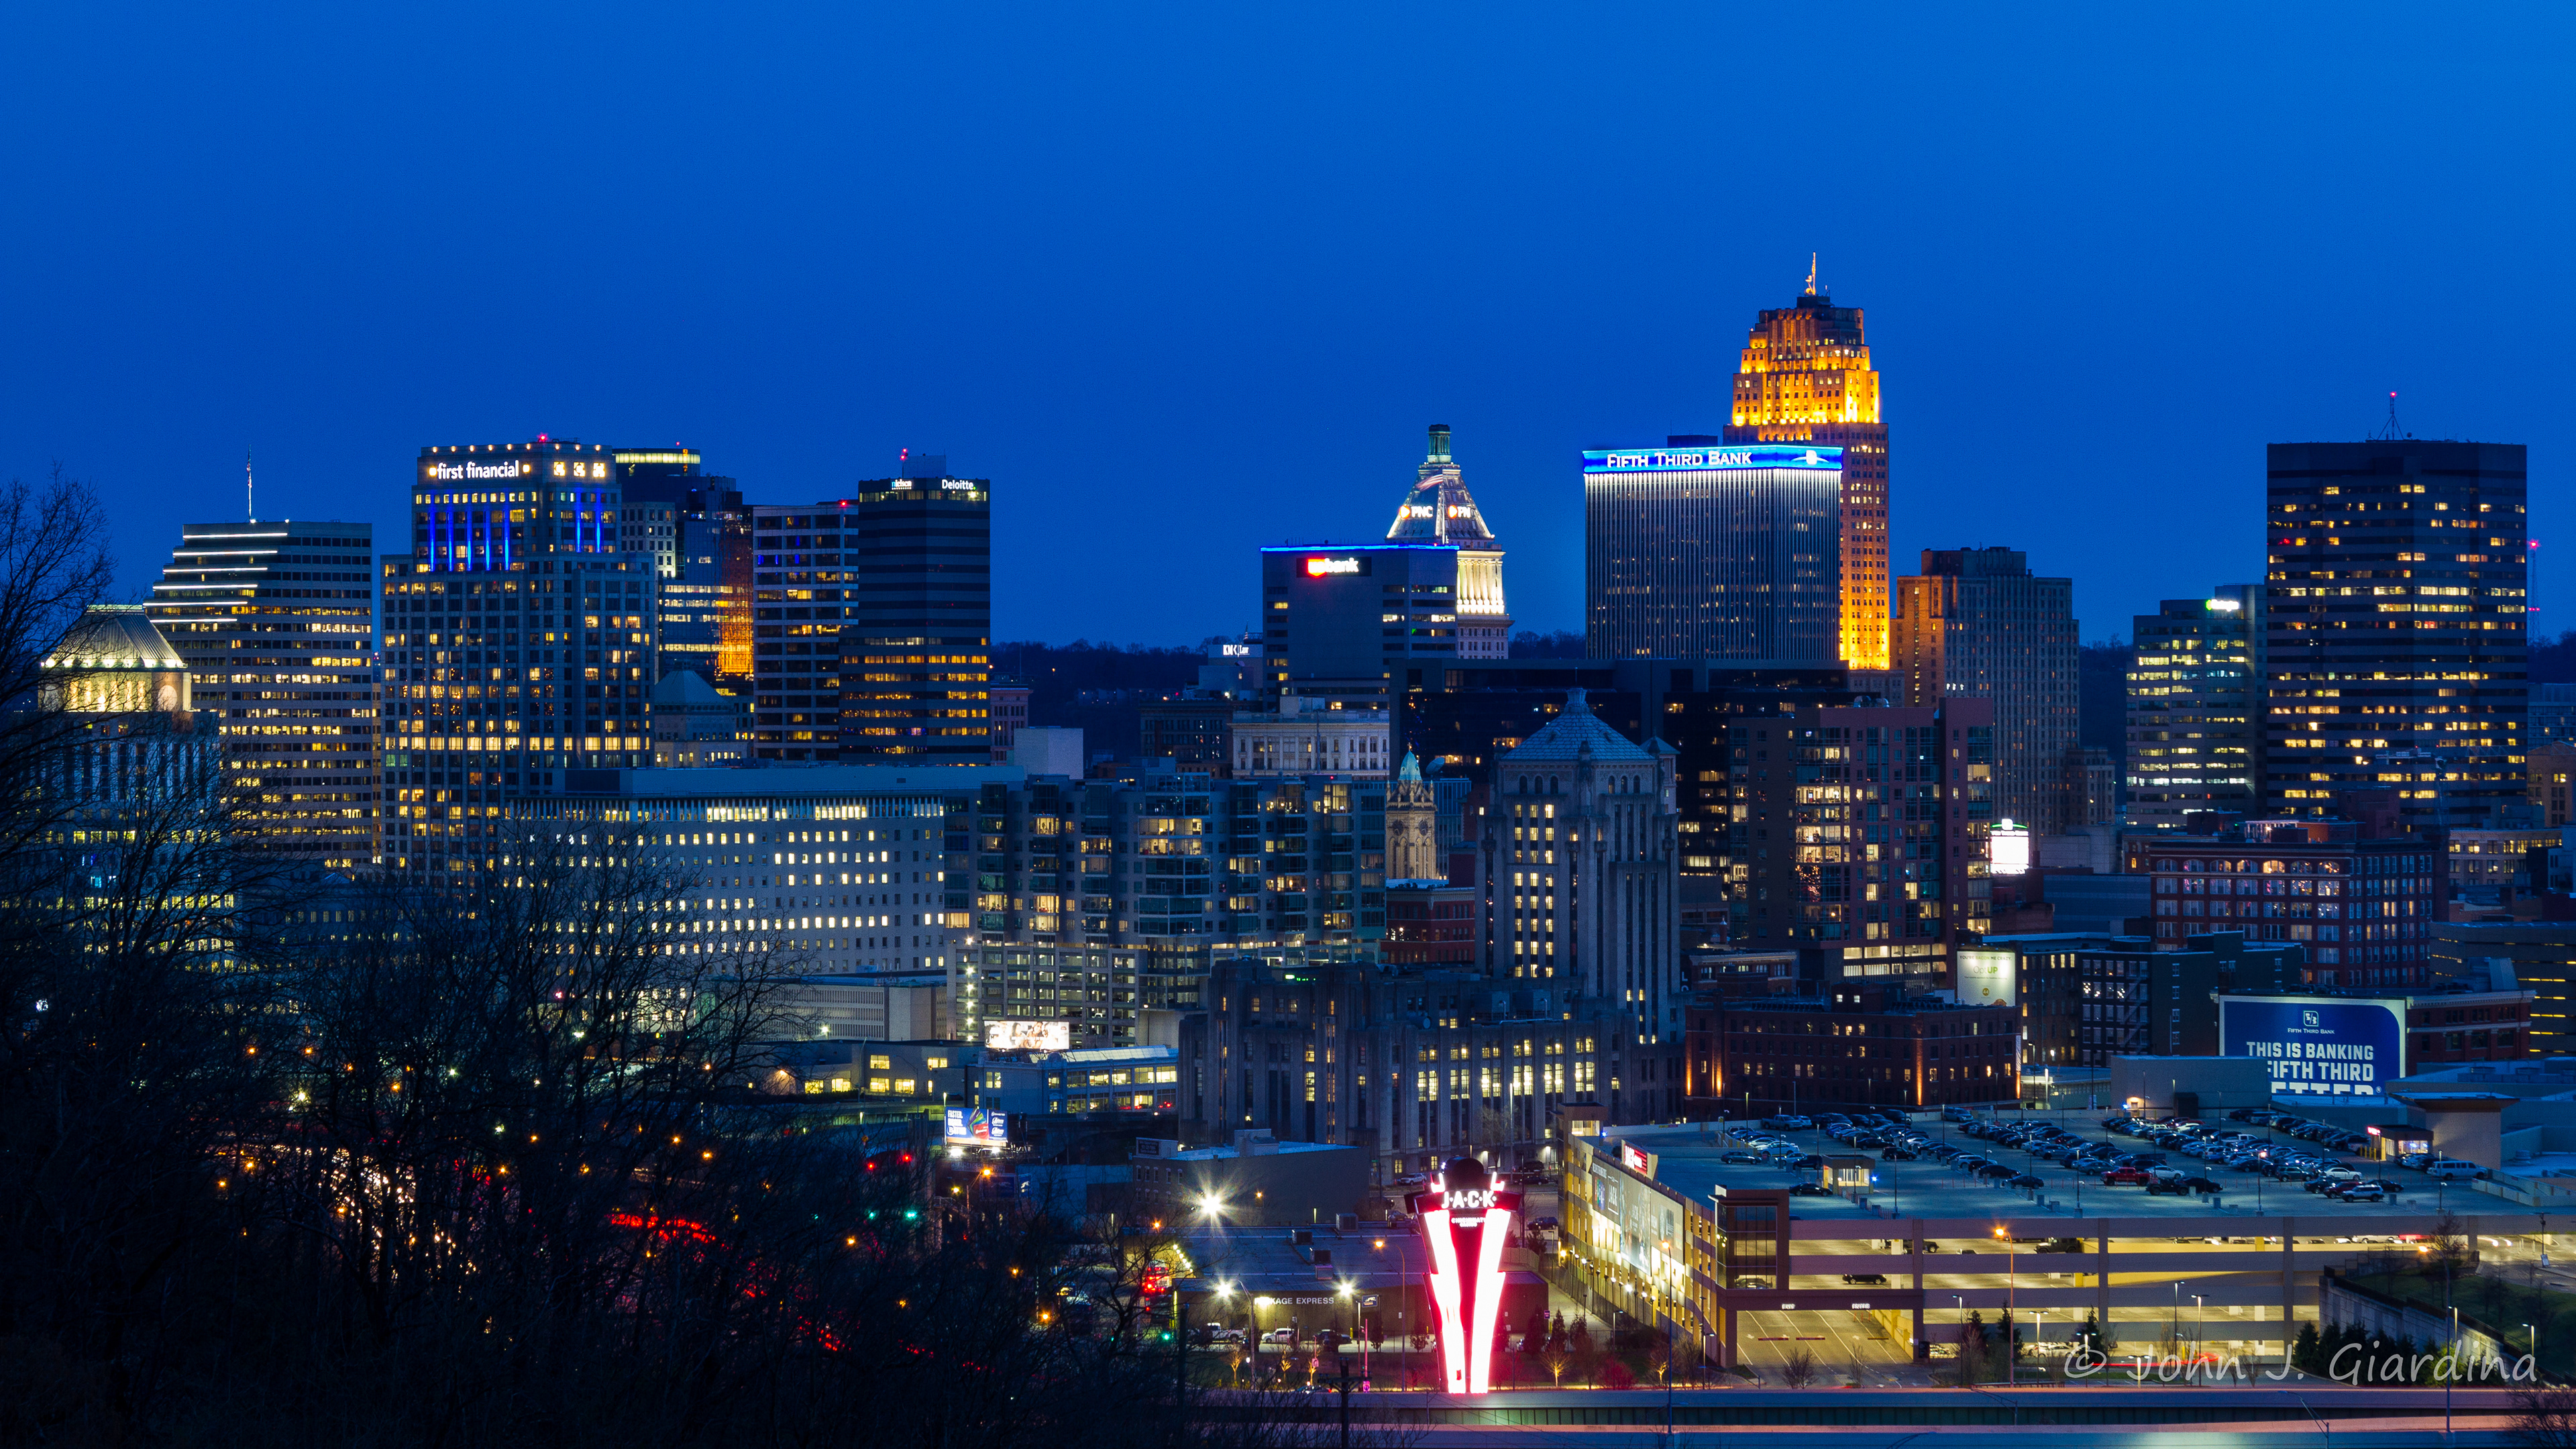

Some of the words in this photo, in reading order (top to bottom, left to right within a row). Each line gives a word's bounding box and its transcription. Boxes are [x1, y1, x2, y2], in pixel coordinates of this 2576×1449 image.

[1607, 454, 1649, 468] FIFTH
[1654, 452, 1703, 466] THIRD
[1708, 451, 1753, 465] BANK
[437, 462, 464, 479] first
[466, 460, 519, 478] financial
[1411, 506, 1434, 518] PNC
[2247, 1041, 2282, 1058] THIS
[2286, 1042, 2301, 1058] IS
[2306, 1044, 2374, 1061] BANKING
[2318, 1063, 2374, 1081] THIRD
